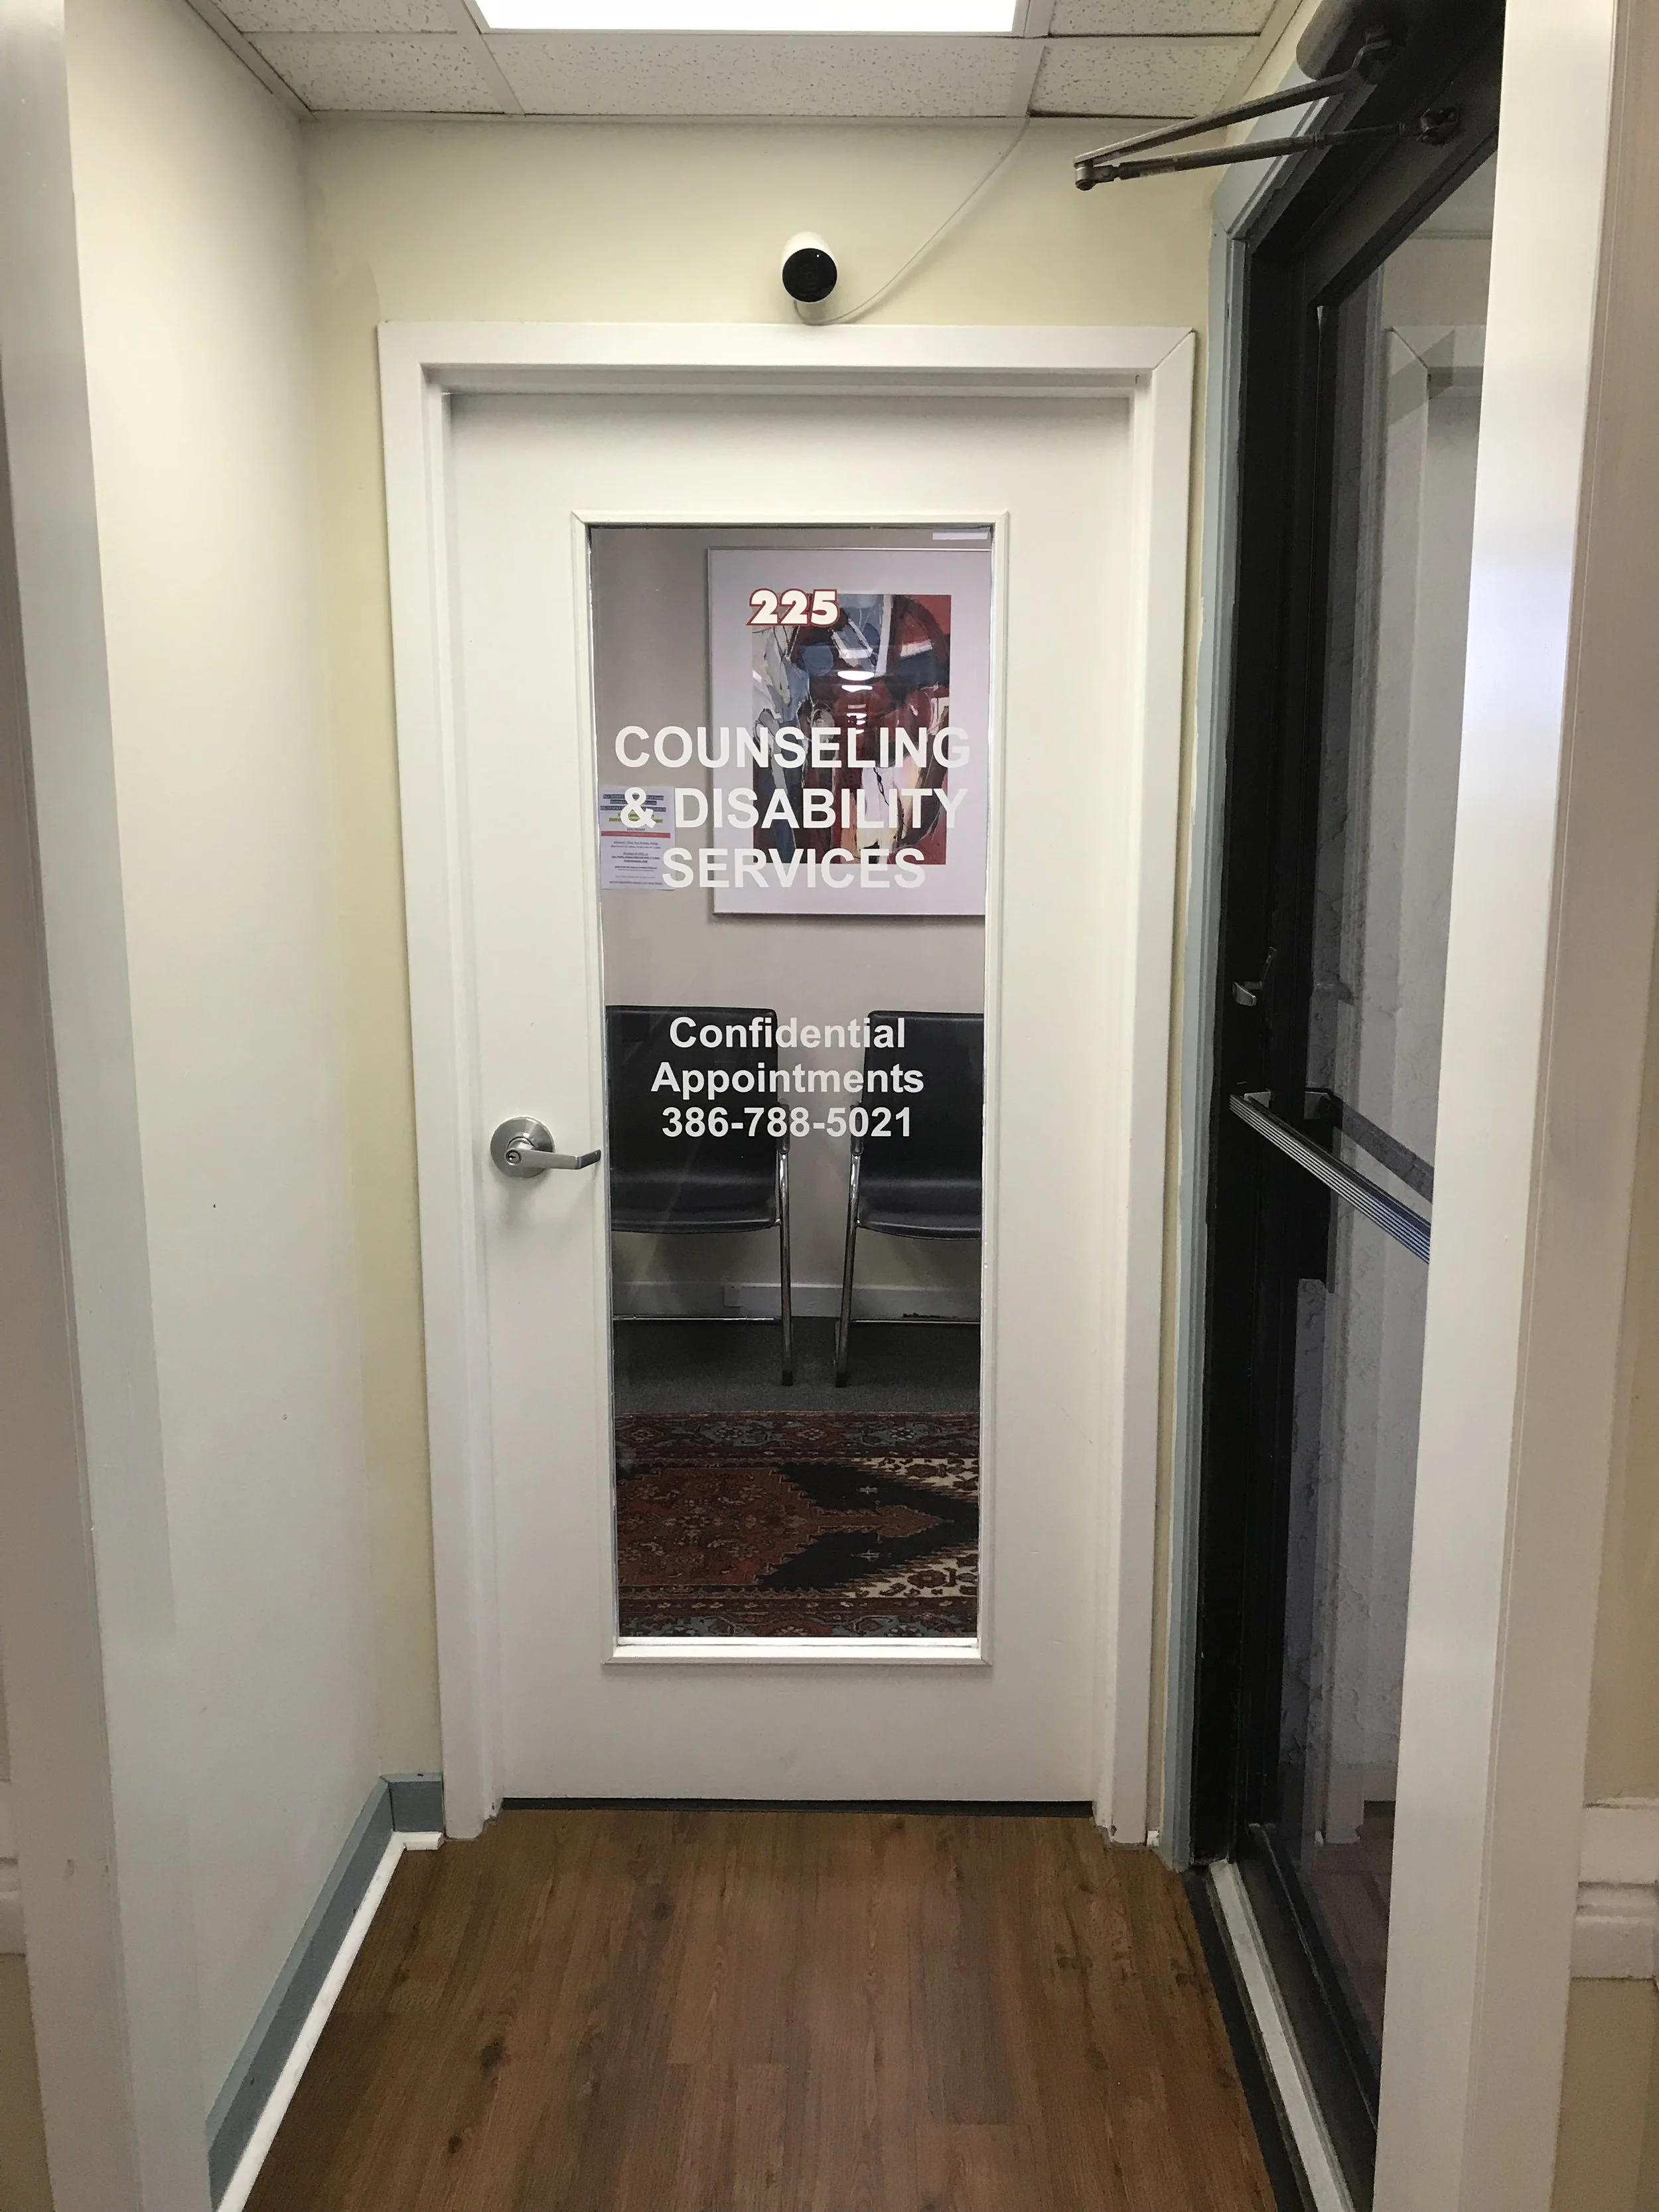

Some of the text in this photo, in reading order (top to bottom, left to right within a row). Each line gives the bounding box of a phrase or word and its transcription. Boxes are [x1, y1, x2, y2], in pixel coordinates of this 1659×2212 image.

[746, 588, 840, 628] 225
[614, 725, 970, 769] COUNSELING
[620, 786, 969, 829] & DISABILITY
[662, 847, 926, 889] SERVICES
[670, 1016, 905, 1049] Confidential
[650, 1062, 924, 1100] Appointments
[662, 1106, 910, 1138] 386-788-5021
